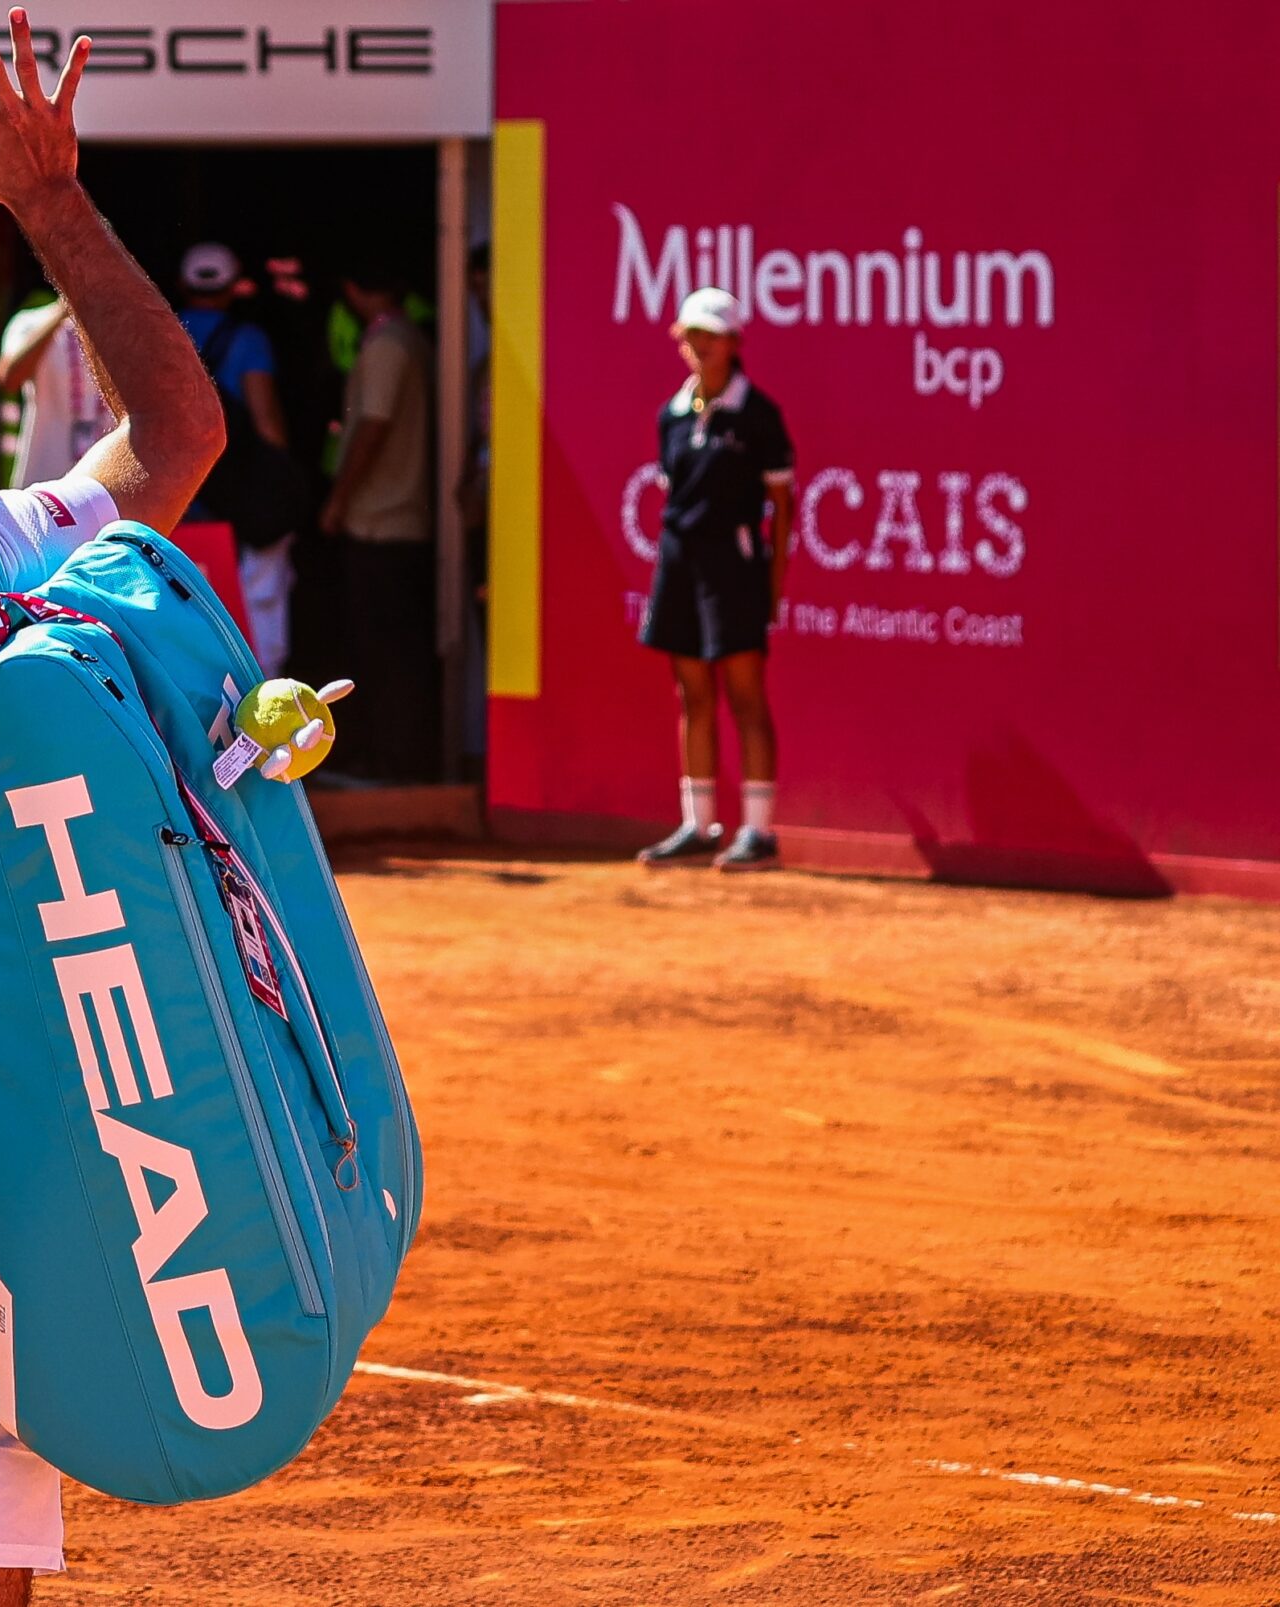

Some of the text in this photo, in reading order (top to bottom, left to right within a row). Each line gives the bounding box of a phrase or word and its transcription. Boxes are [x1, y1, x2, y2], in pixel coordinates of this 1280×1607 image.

[612, 201, 1056, 328] Millennium
[914, 331, 1004, 409] bcp
[621, 461, 1028, 578] CCAIS
[794, 603, 838, 637] the
[842, 603, 940, 643] Atlantic
[945, 606, 1025, 646] Coast
[5, 774, 264, 1430] HEAD
